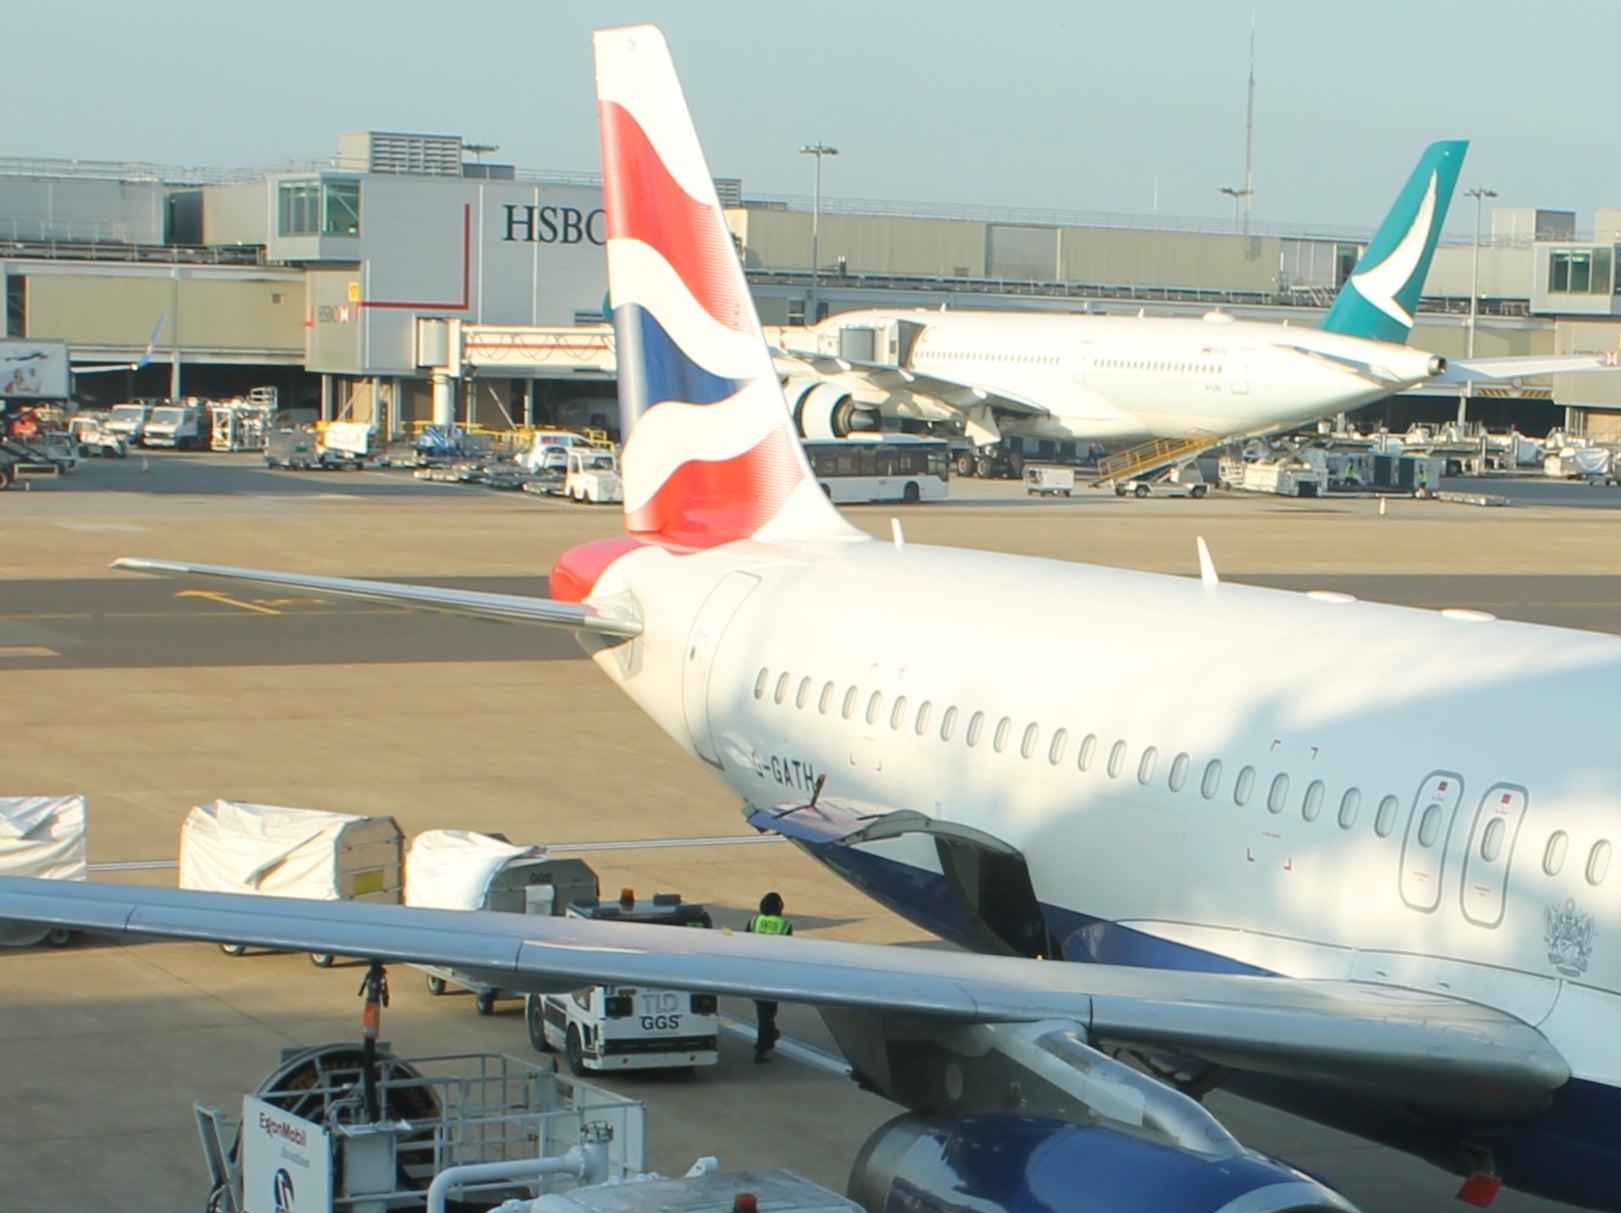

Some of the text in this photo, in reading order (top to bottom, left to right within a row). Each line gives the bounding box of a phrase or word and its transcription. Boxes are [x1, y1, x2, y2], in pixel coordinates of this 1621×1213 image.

[502, 204, 607, 246] HSBC
[641, 993, 679, 1013] TLD
[641, 1015, 681, 1031] GGS
